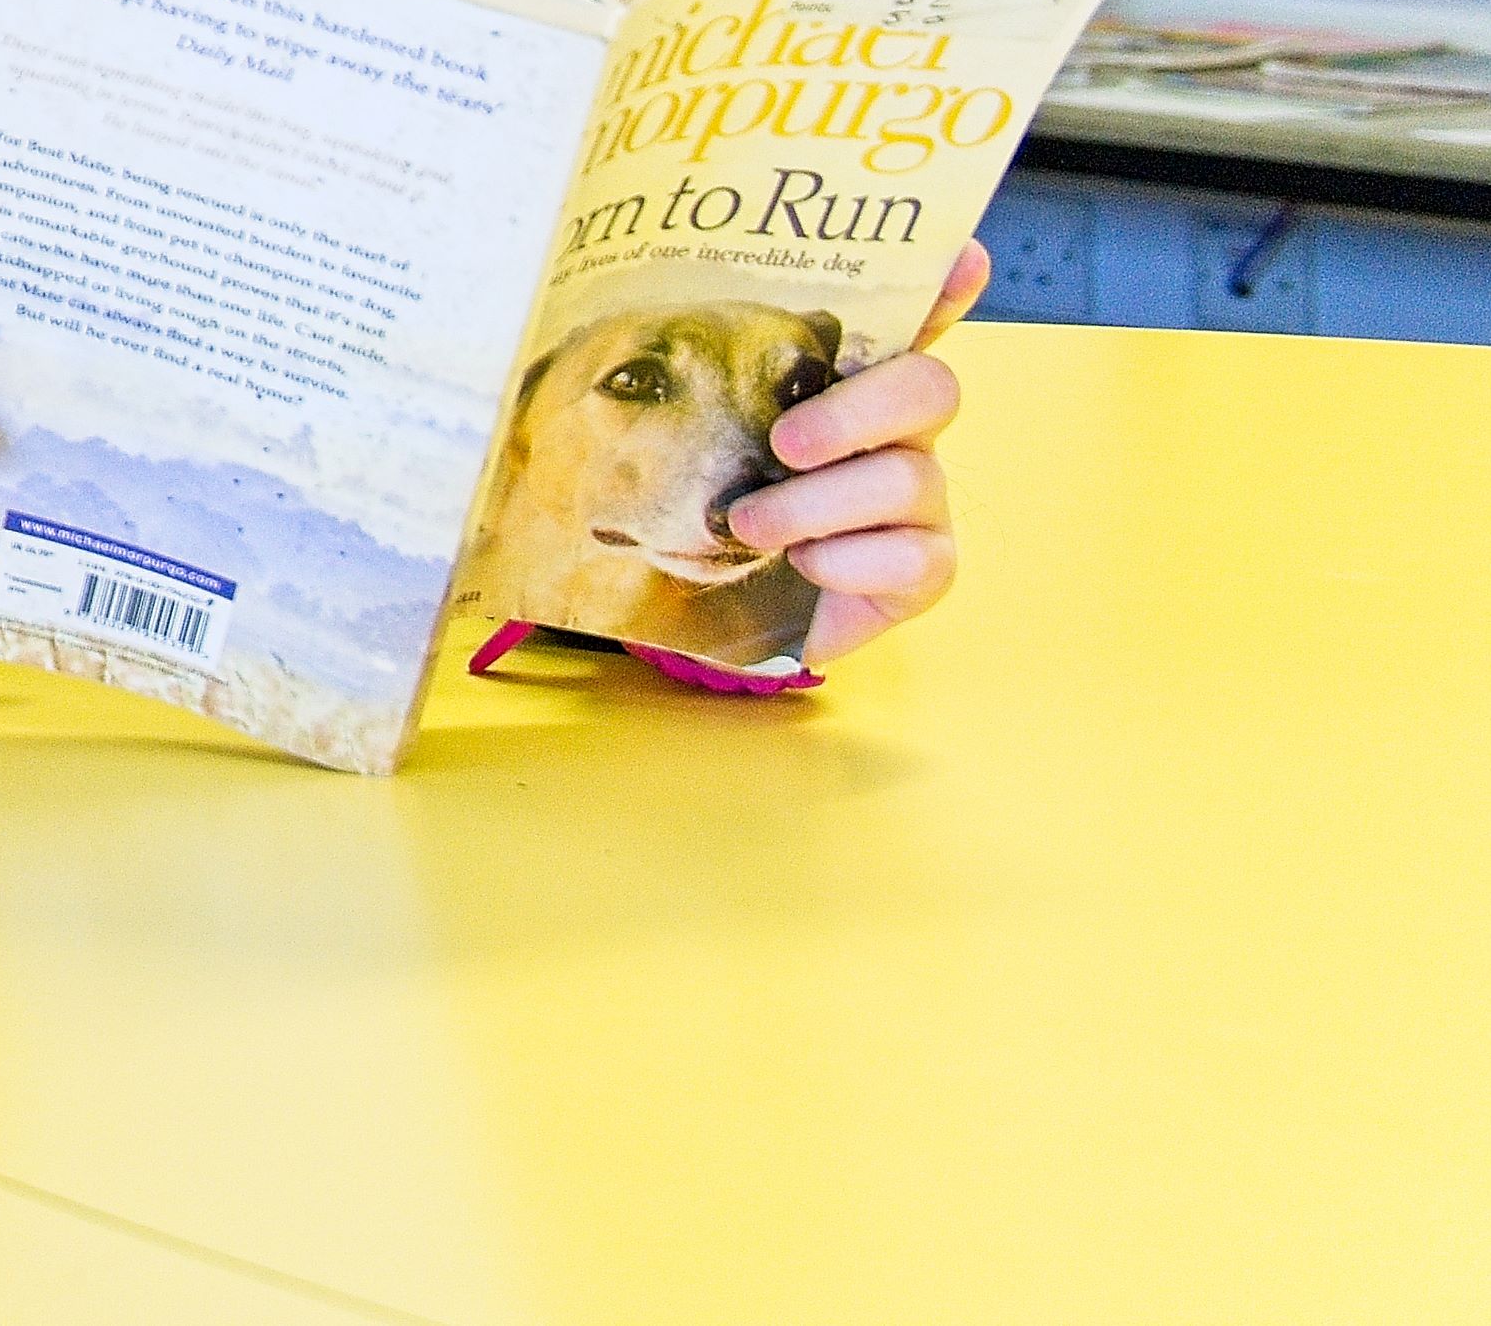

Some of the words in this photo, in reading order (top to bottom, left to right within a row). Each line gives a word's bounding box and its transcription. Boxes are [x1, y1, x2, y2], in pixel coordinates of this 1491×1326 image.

[173, 32, 236, 67] Daily
[233, 21, 257, 42] to
[261, 30, 321, 63] wipe
[323, 50, 385, 83] away
[389, 68, 431, 96] the
[309, 14, 427, 62] hardened
[429, 50, 491, 83] book
[661, 176, 743, 233] to
[746, 166, 924, 245] Run
[15, 207, 118, 249] remarkable
[118, 239, 219, 281] greyhound
[218, 272, 282, 303] proves
[283, 292, 322, 317] that
[354, 319, 387, 340] not
[85, 205, 120, 227] and
[122, 217, 165, 242] from
[167, 233, 200, 255] pet
[202, 243, 222, 259] to
[221, 249, 315, 291] champion
[316, 281, 354, 302] race
[357, 295, 400, 321] dog.
[621, 242, 649, 264] of
[650, 243, 690, 261] one
[697, 245, 815, 268] incredible
[821, 250, 867, 273] dog
[18, 517, 222, 590] www.michaelmorpurgo.com
